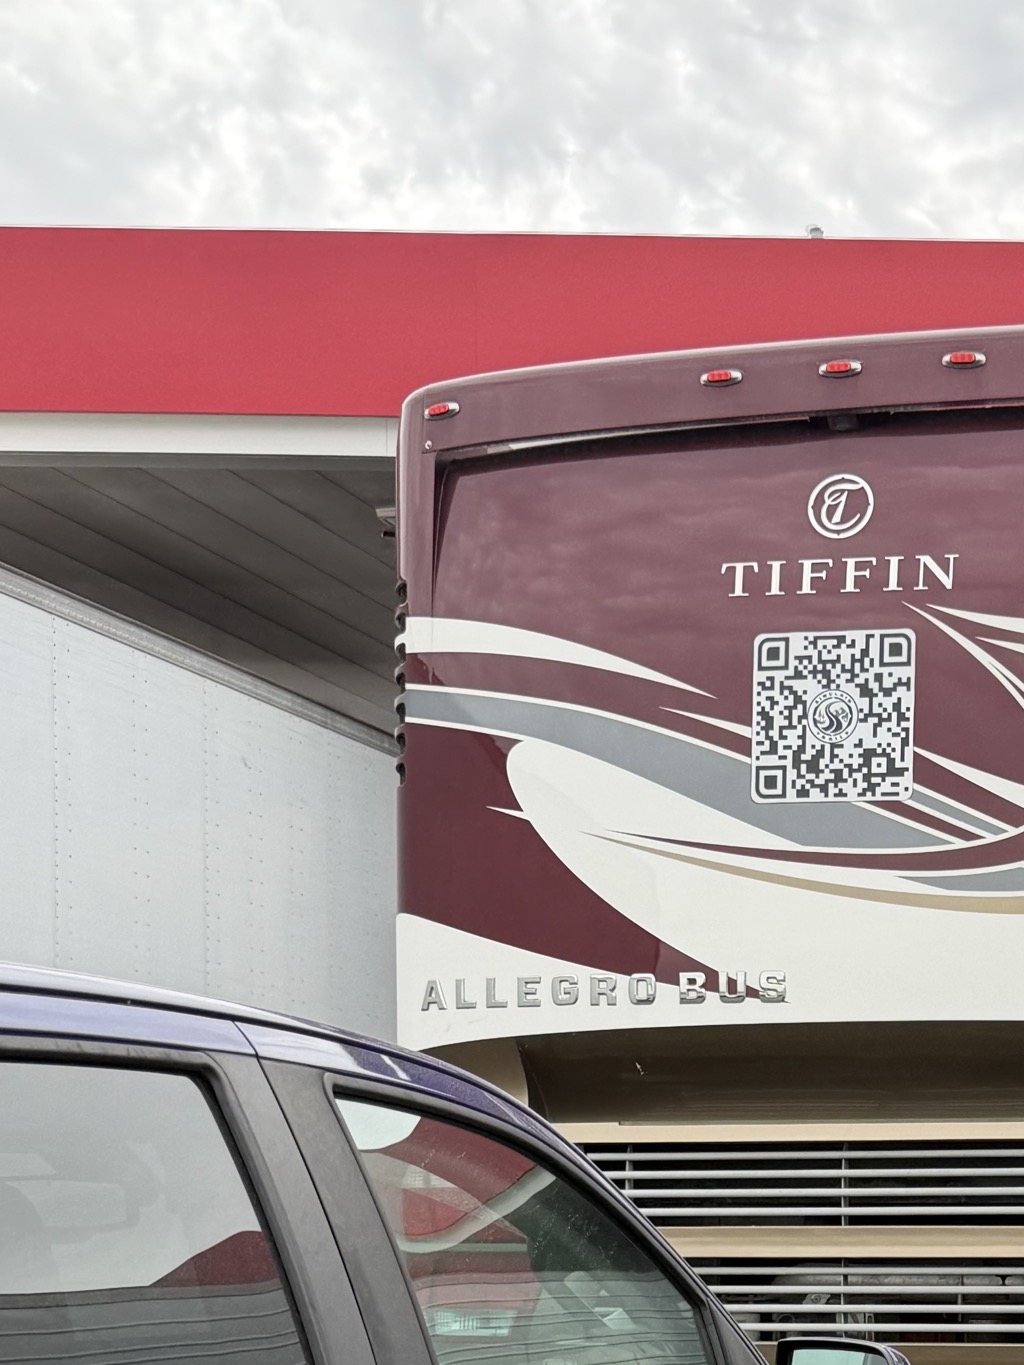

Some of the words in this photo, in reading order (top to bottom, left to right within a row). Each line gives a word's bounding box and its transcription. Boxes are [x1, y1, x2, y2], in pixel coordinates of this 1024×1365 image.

[721, 554, 959, 597] TIFFIN
[421, 973, 657, 1011] ALLEGRO
[678, 969, 787, 1005] BUS
